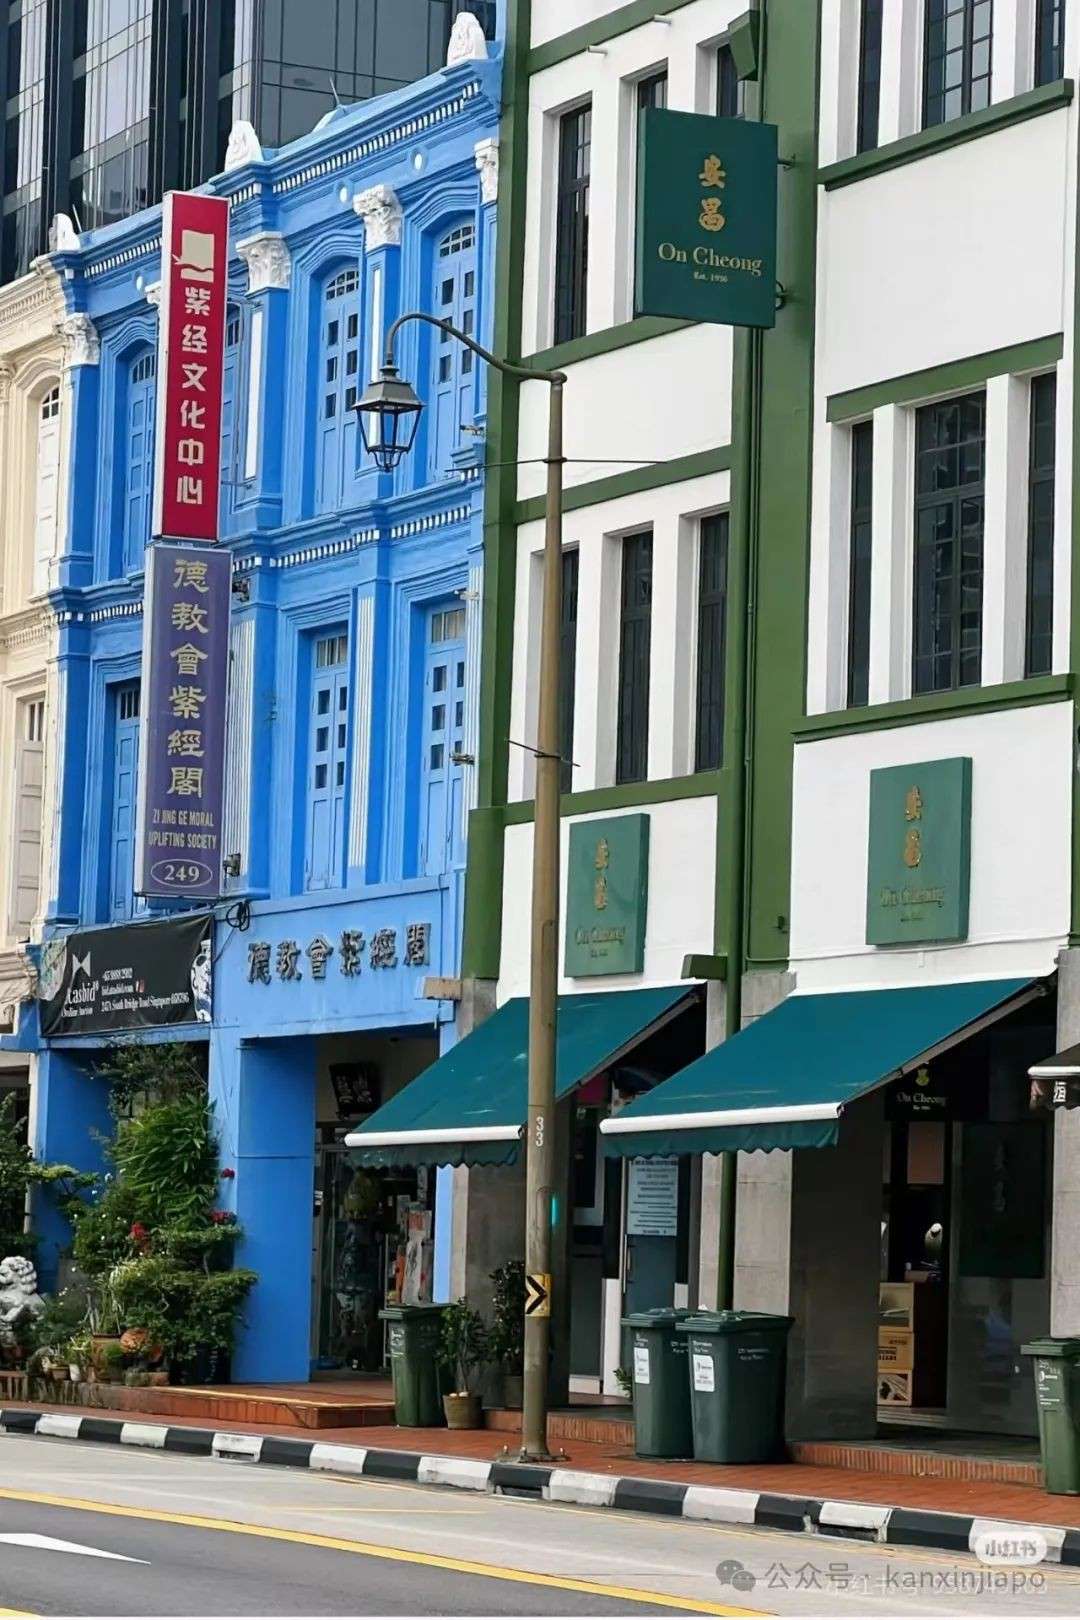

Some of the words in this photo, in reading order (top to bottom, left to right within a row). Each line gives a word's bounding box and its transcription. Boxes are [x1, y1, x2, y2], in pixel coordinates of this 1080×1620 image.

[658, 242, 688, 263] On
[692, 246, 762, 277] Cheong
[176, 286, 211, 505] 紫经文化中心
[167, 559, 209, 798] 德教會紫經閣
[152, 808, 160, 824] ZI
[178, 810, 188, 825] GE
[189, 811, 214, 827] MORAL
[148, 831, 185, 848] UPLIFTING
[187, 833, 217, 849] SOCIETY
[164, 864, 200, 882] 249
